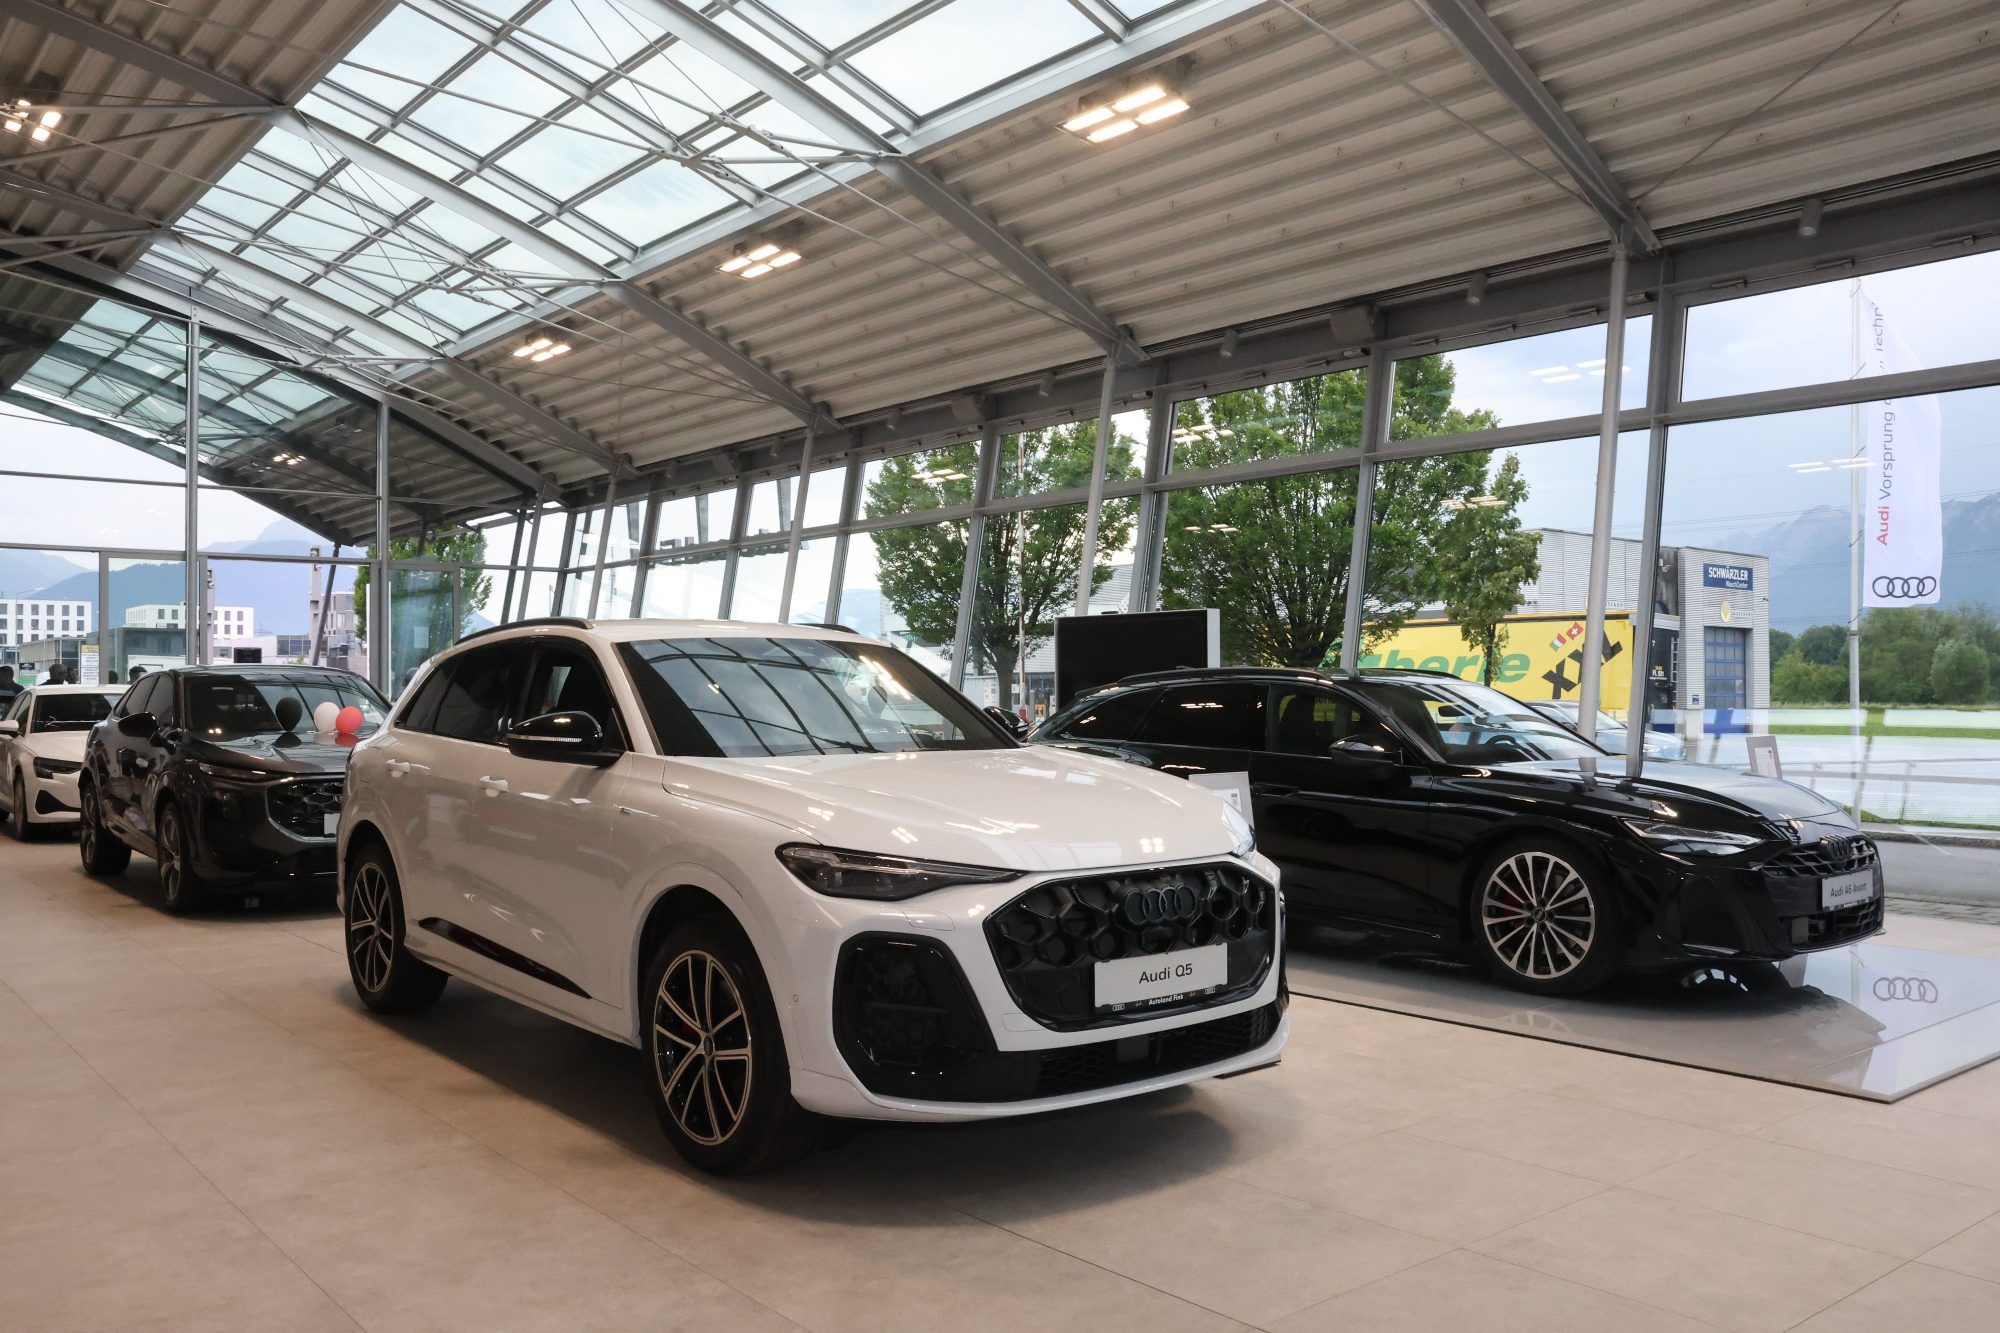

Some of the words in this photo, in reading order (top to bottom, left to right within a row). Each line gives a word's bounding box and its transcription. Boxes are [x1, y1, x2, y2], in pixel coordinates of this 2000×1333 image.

[1879, 412, 1896, 500] Vorsprung
[1877, 506, 1890, 545] Audi
[1708, 565, 1748, 580] SCHWÄRZLER
[1831, 886, 1844, 897] Audi
[1139, 967, 1171, 984] Audi
[1175, 963, 1193, 977] Q5
